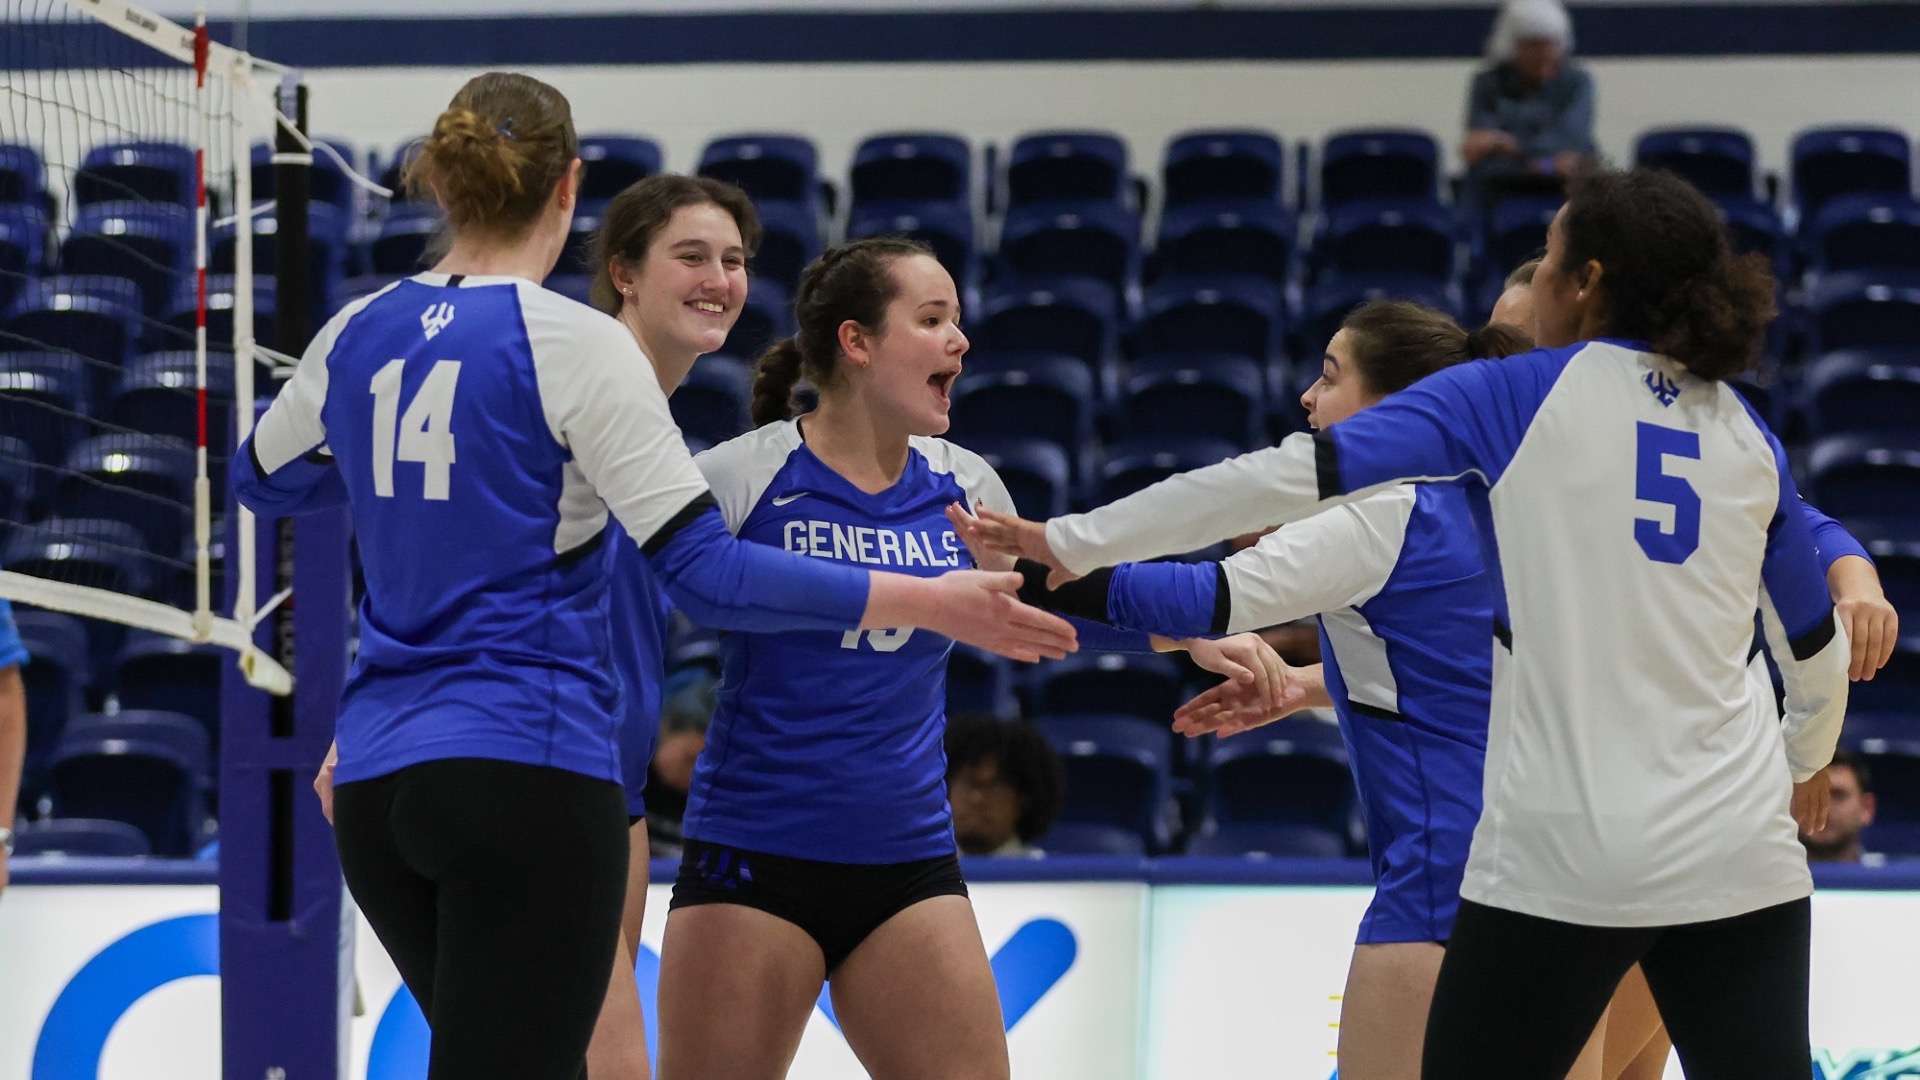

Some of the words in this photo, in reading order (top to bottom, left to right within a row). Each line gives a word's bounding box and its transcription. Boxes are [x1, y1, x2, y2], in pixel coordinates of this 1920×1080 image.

[369, 358, 462, 500] 14
[1634, 420, 1702, 565] 5
[783, 520, 960, 567] GENERALS
